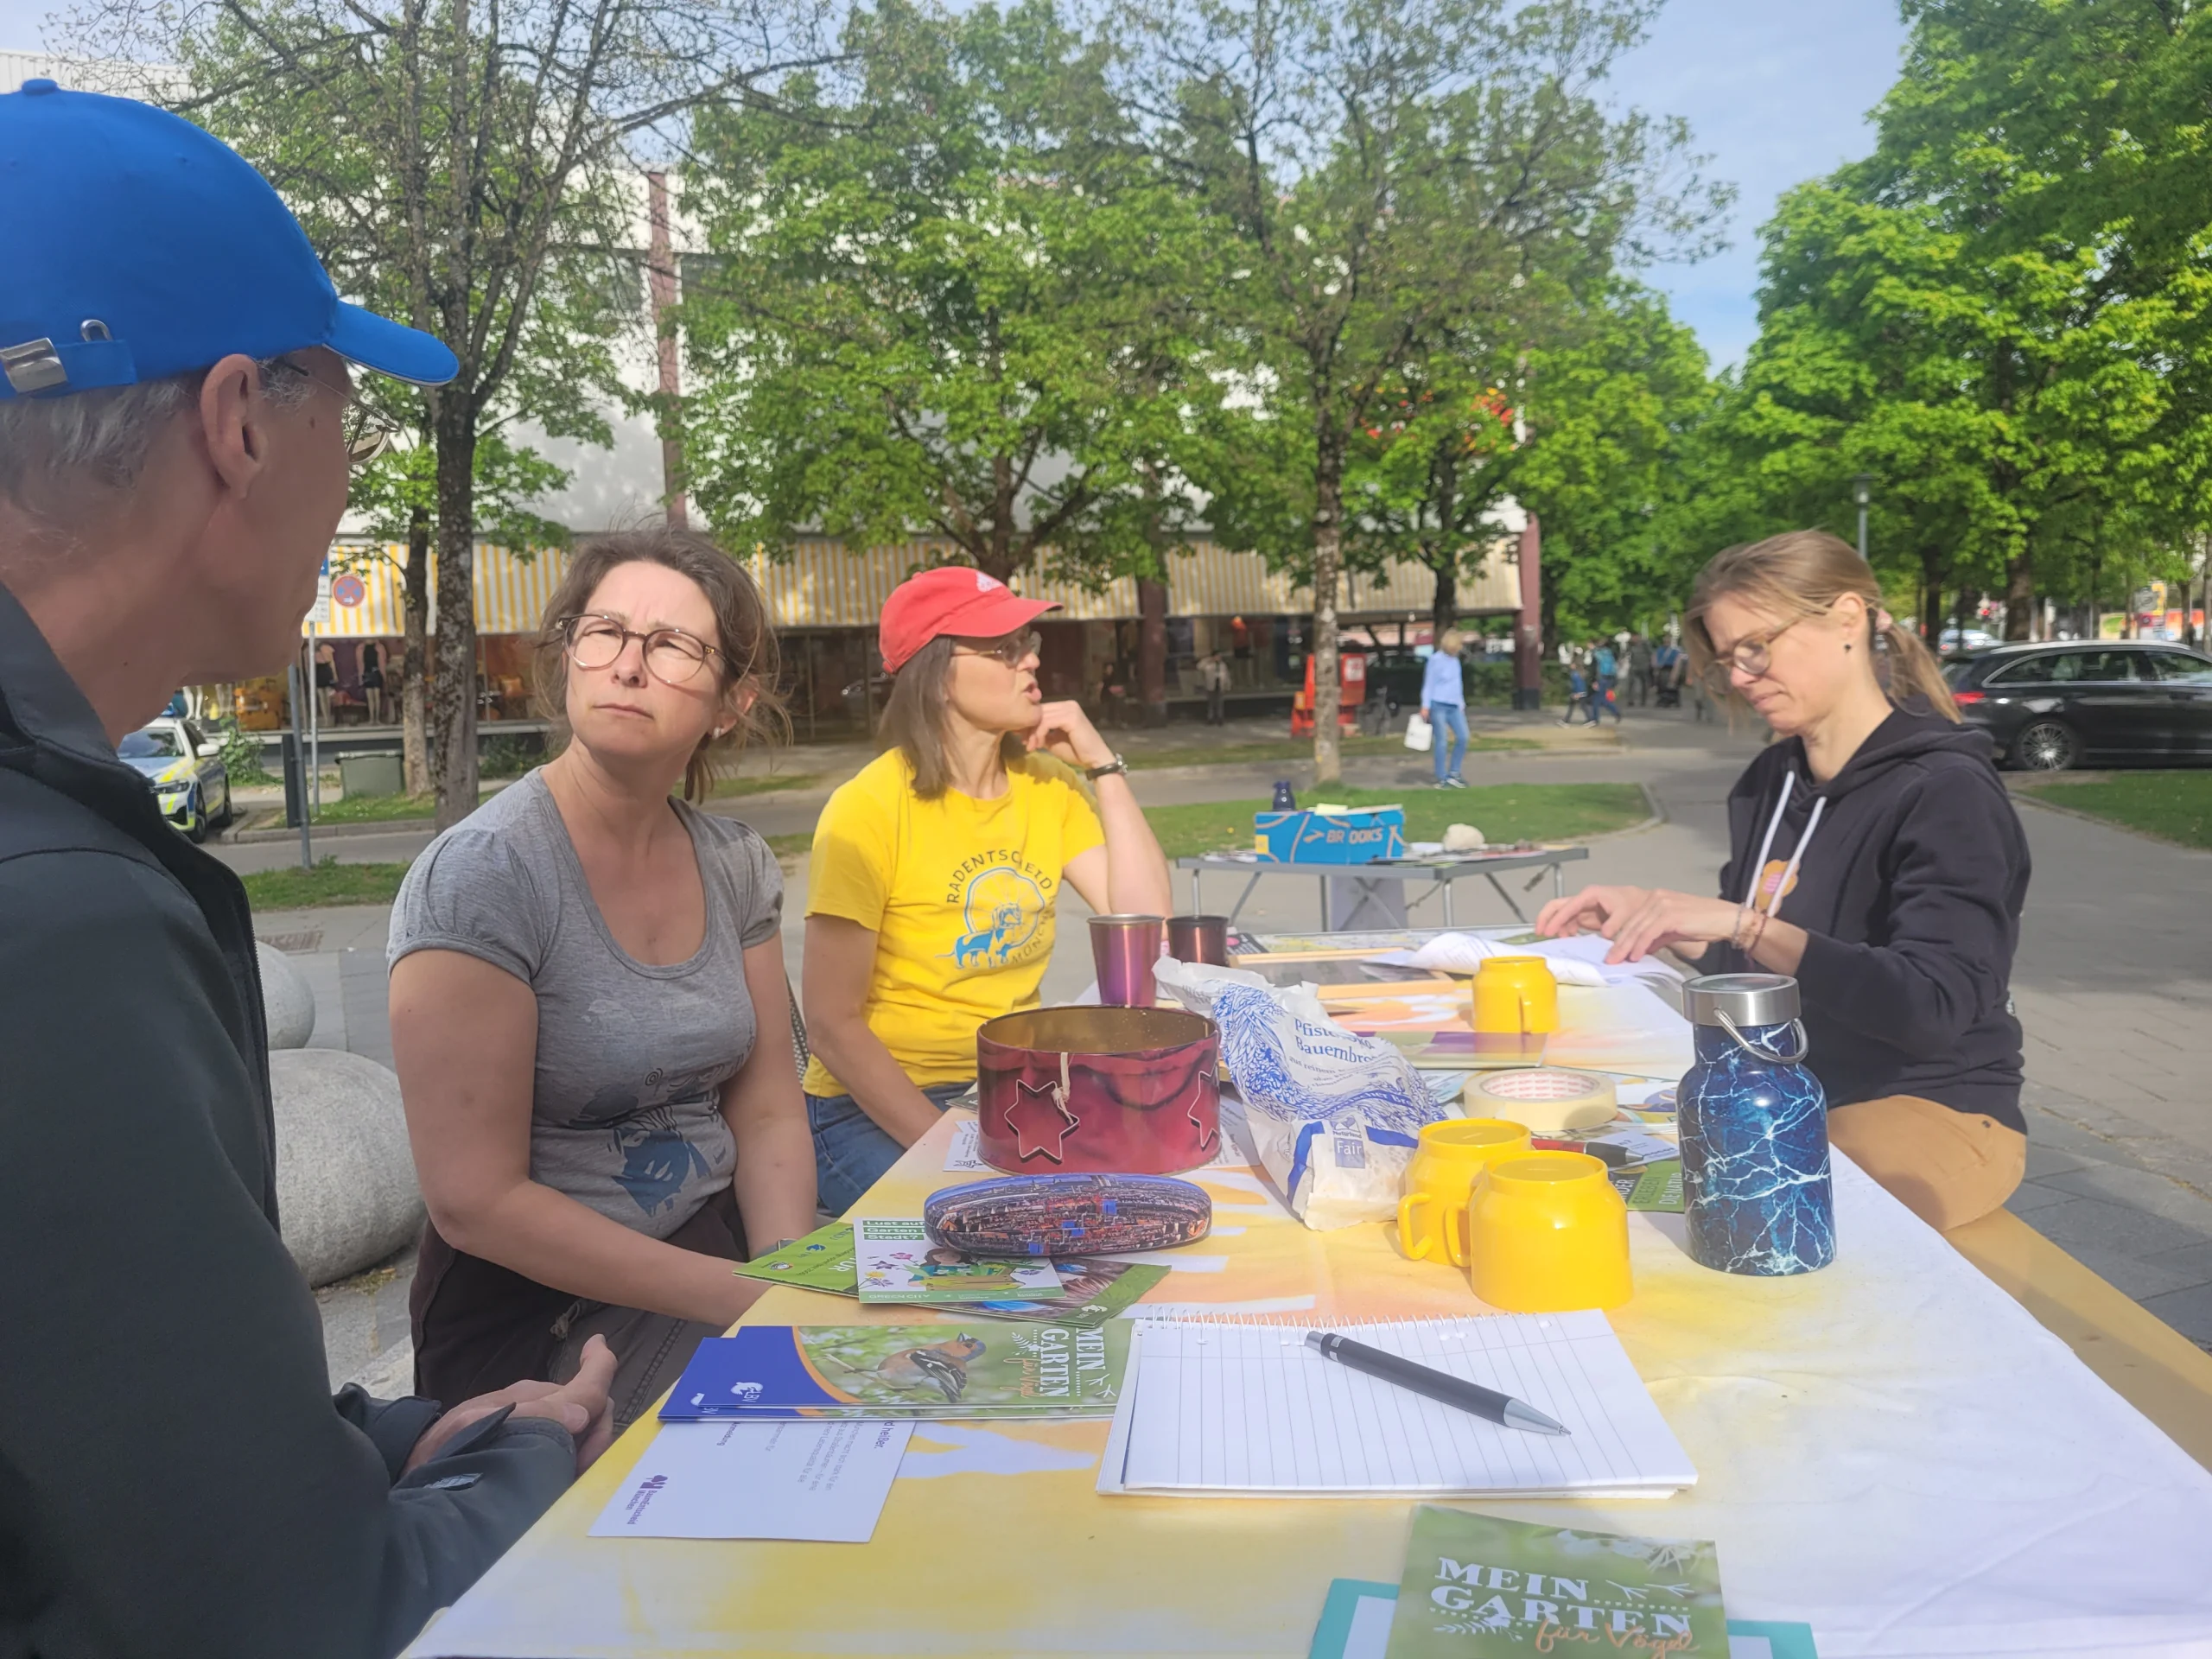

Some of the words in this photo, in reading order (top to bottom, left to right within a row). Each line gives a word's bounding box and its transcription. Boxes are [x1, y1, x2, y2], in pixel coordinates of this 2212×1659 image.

[1326, 829, 1382, 844] BROOKS
[1294, 1018, 1339, 1038] Pfist
[1337, 1141, 1363, 1155] Fair
[1659, 1192, 1681, 1205] DIE
[1039, 1328, 1070, 1397] GARTEN
[1076, 1326, 1106, 1370] MEIN
[1434, 1556, 1589, 1601] MEIN
[1430, 1586, 1691, 1637] GARTEN
[1535, 1618, 1600, 1652] für
